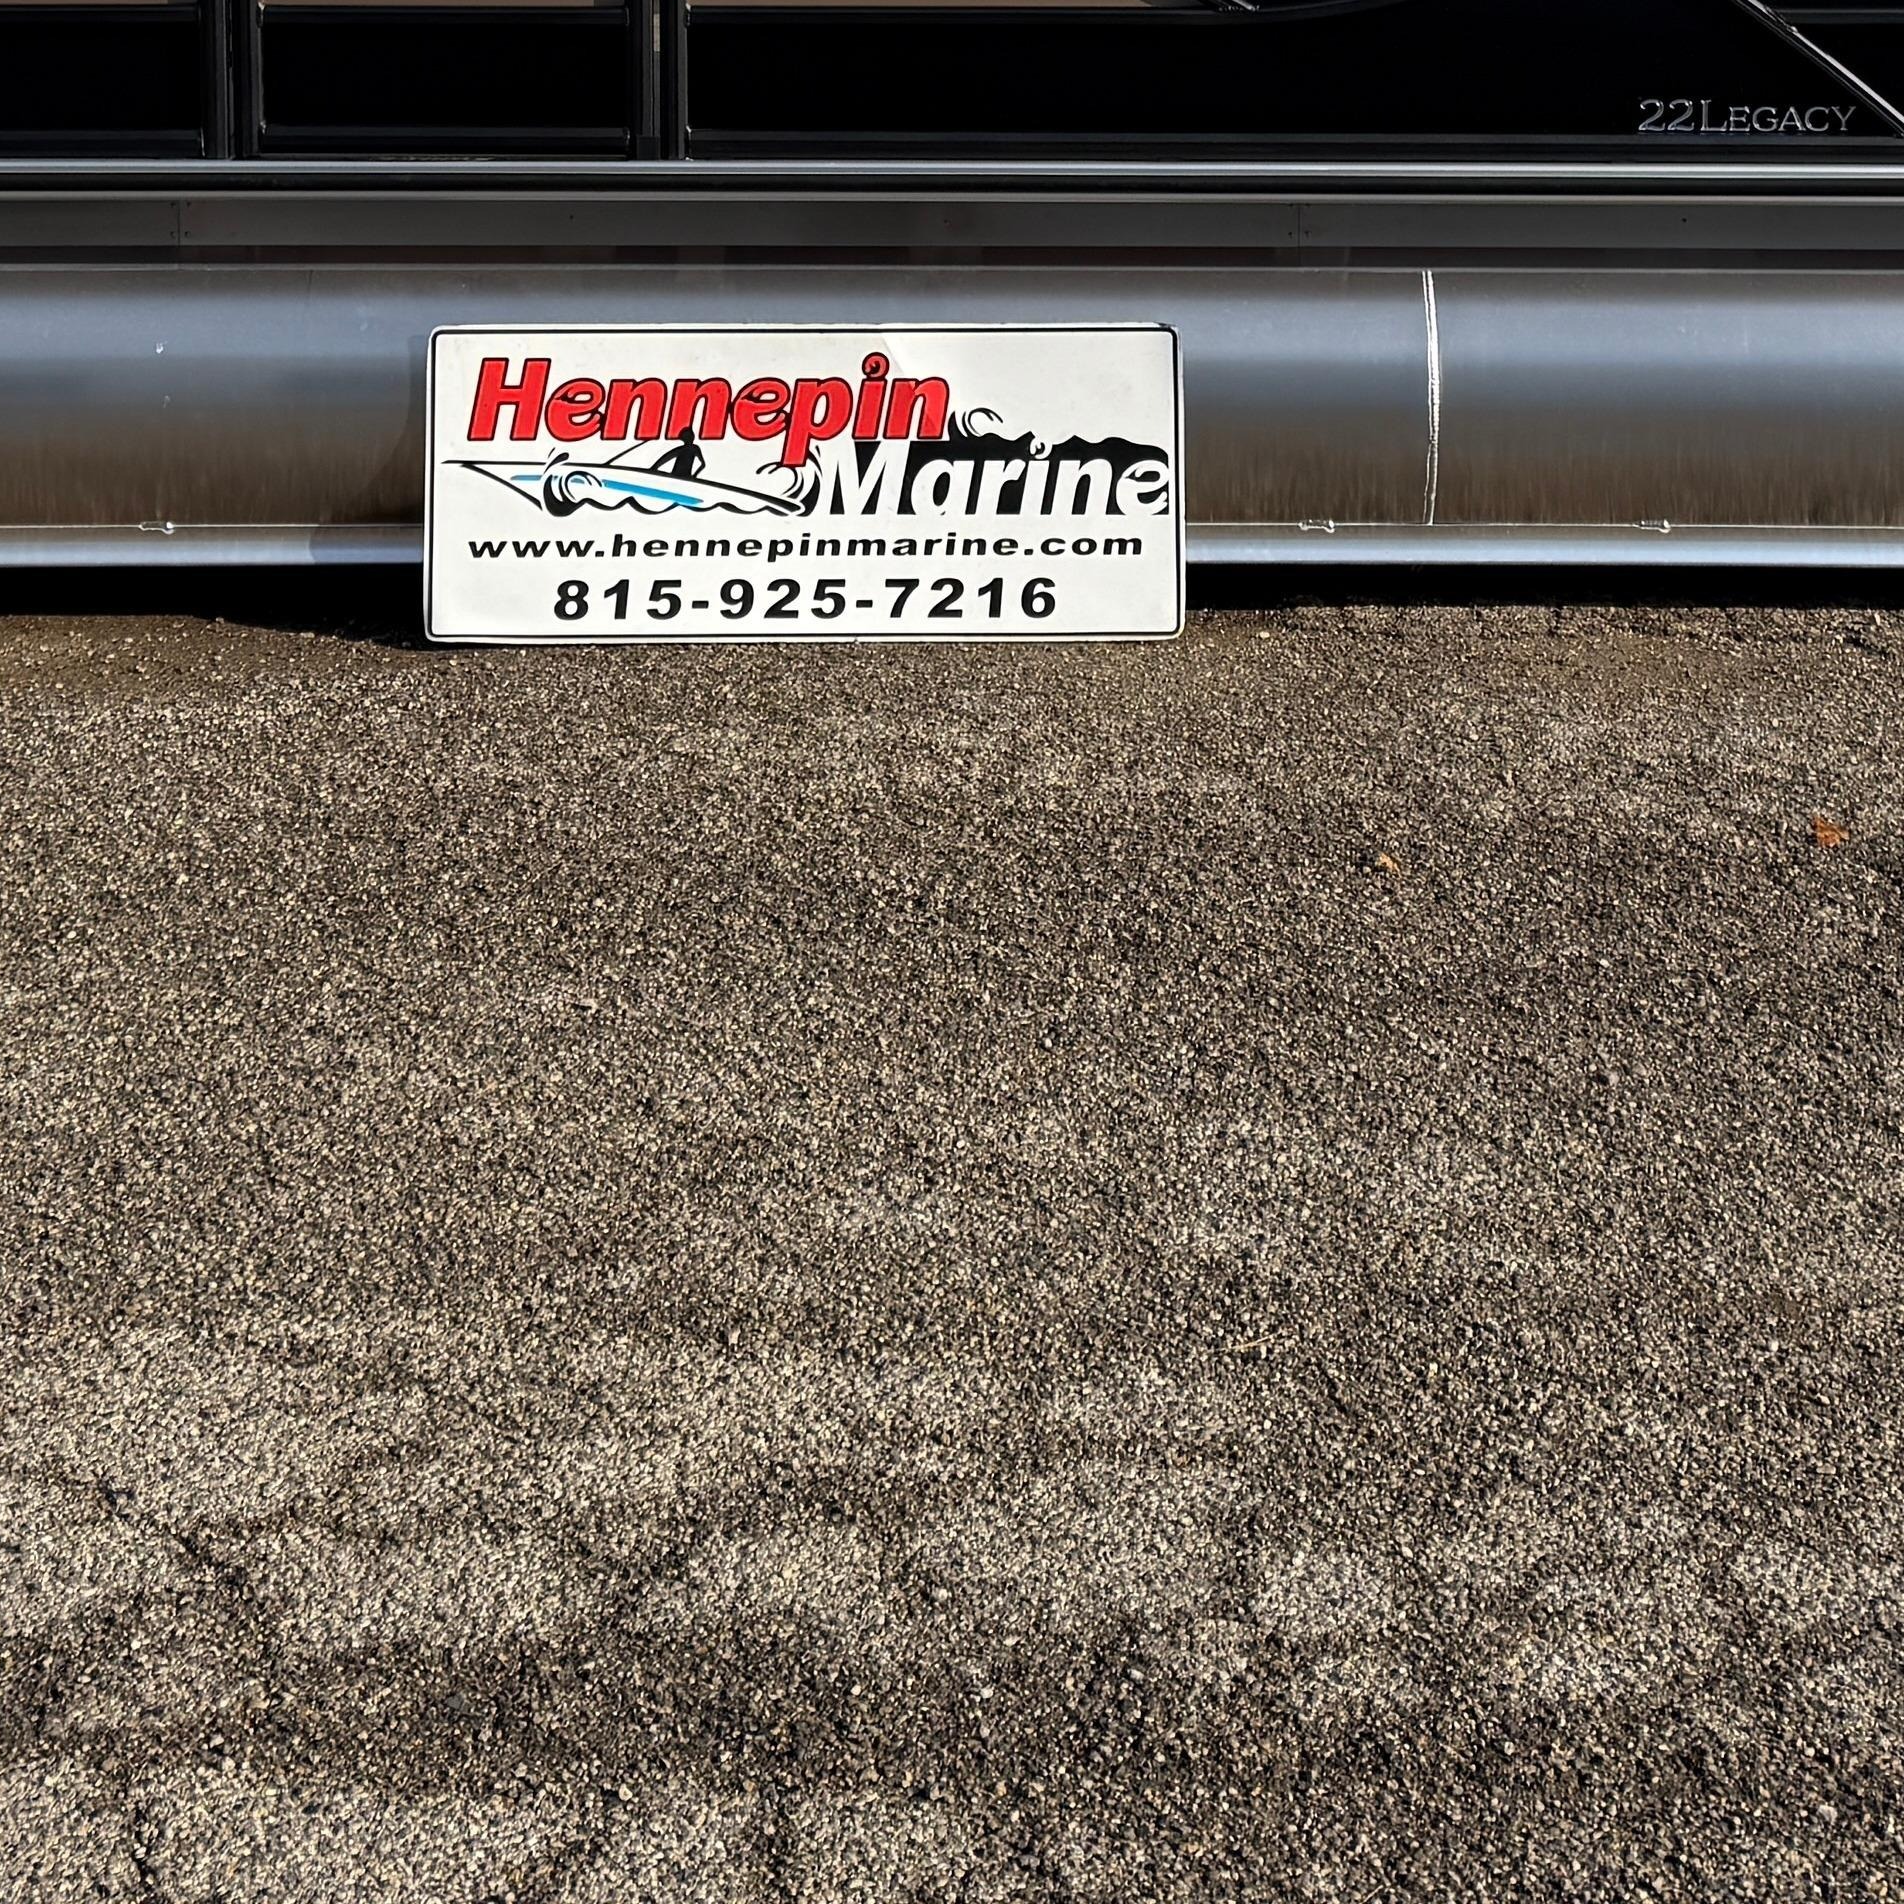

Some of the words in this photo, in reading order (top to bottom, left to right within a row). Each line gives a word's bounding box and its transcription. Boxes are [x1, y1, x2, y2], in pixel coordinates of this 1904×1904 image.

[467, 351, 950, 468] Hennepin
[813, 433, 1171, 516] Marine
[468, 532, 1143, 563] www.hennepinmarine.com
[552, 577, 1057, 621] 815-925-7216
